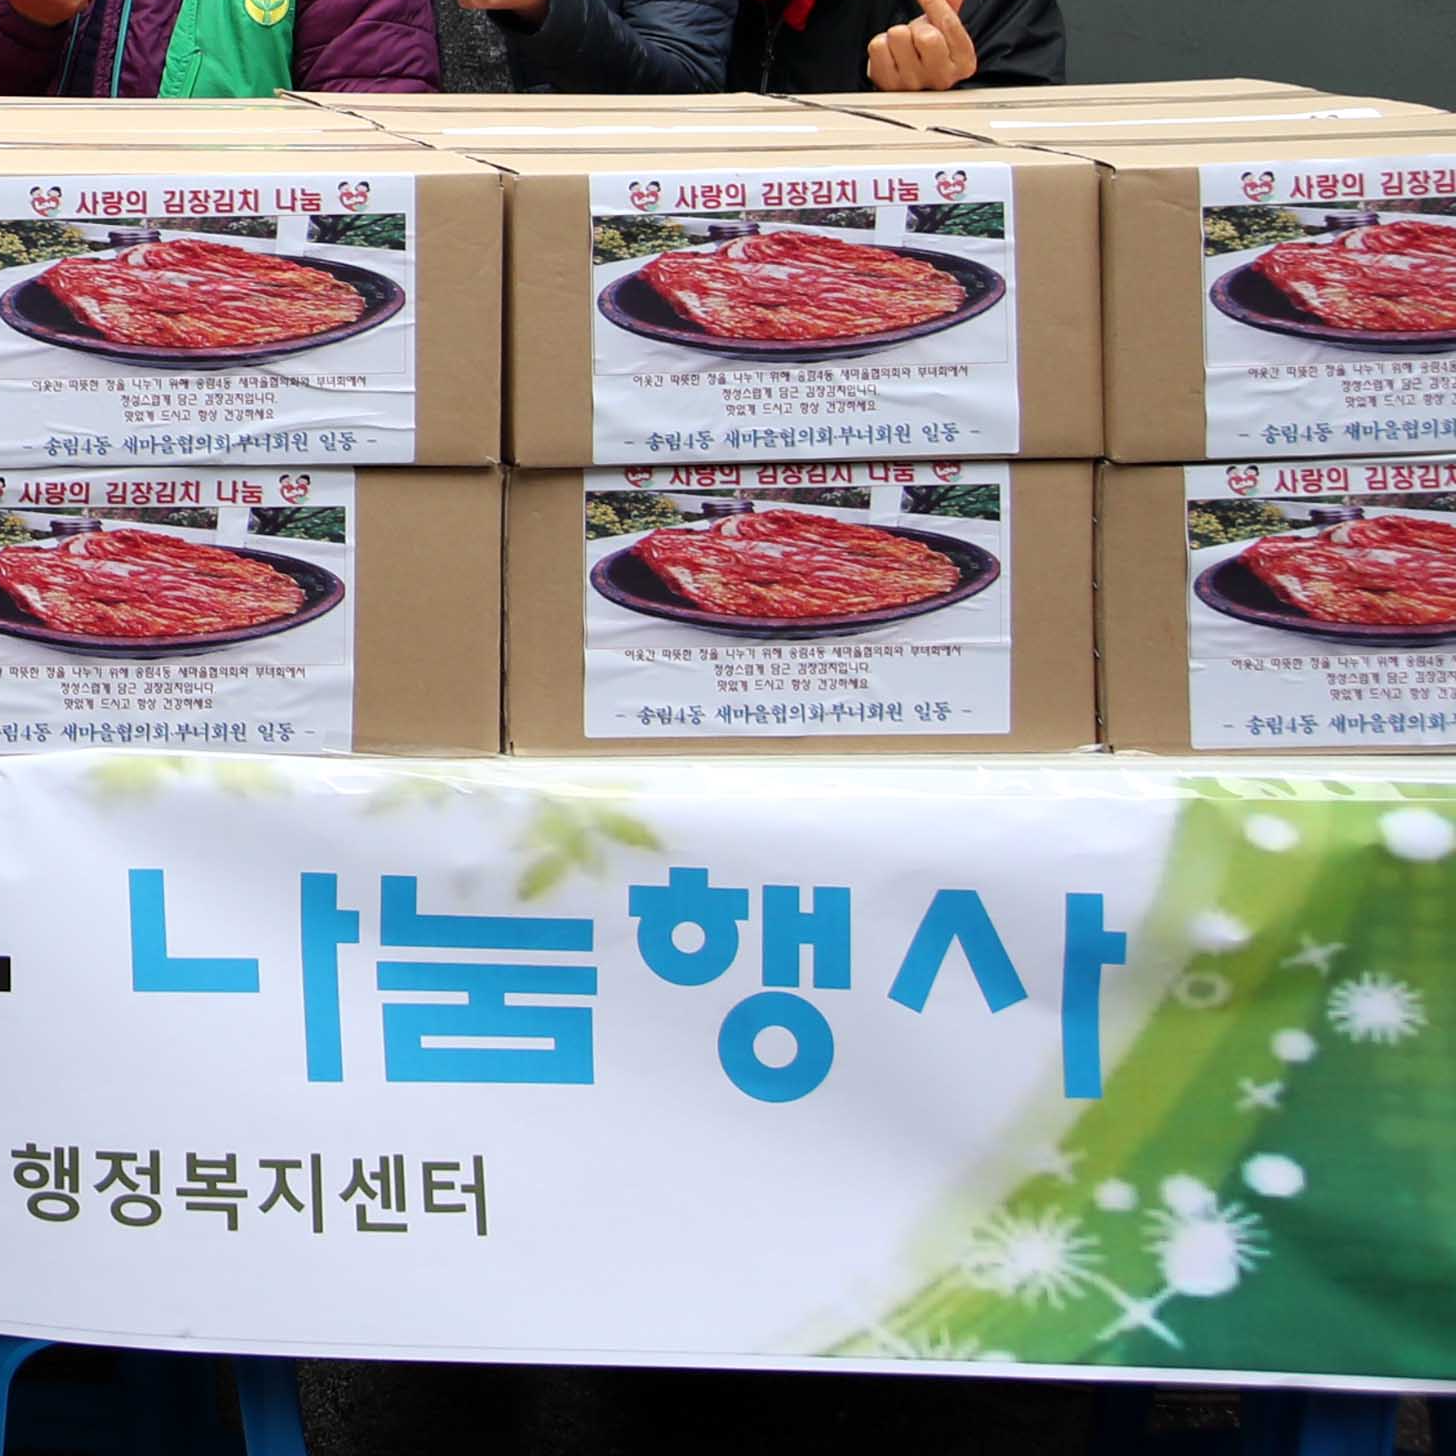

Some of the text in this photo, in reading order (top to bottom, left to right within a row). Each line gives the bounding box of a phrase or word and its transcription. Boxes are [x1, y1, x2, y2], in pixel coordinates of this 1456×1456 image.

[674, 179, 920, 209] 사랑의 김장김치 나눔
[1289, 171, 1365, 200] 사랑의
[76, 189, 321, 217] 사랑의 김장김치 나눔
[42, 431, 113, 457] 송림4동
[319, 431, 357, 452] 일동
[644, 430, 715, 453] 송림4동
[921, 422, 961, 443] 일동
[1261, 422, 1334, 445] 송림4동
[18, 479, 263, 505] 사랑의 김장김치 나눔
[1275, 465, 1349, 494] 사랑의
[636, 704, 705, 726] 송림4동
[913, 701, 953, 722] 일동
[1246, 714, 1319, 736] 송림4동
[257, 721, 295, 743] 일동
[128, 865, 1128, 1103] 나눔행사
[10, 1141, 490, 1237] 행정복지센터
